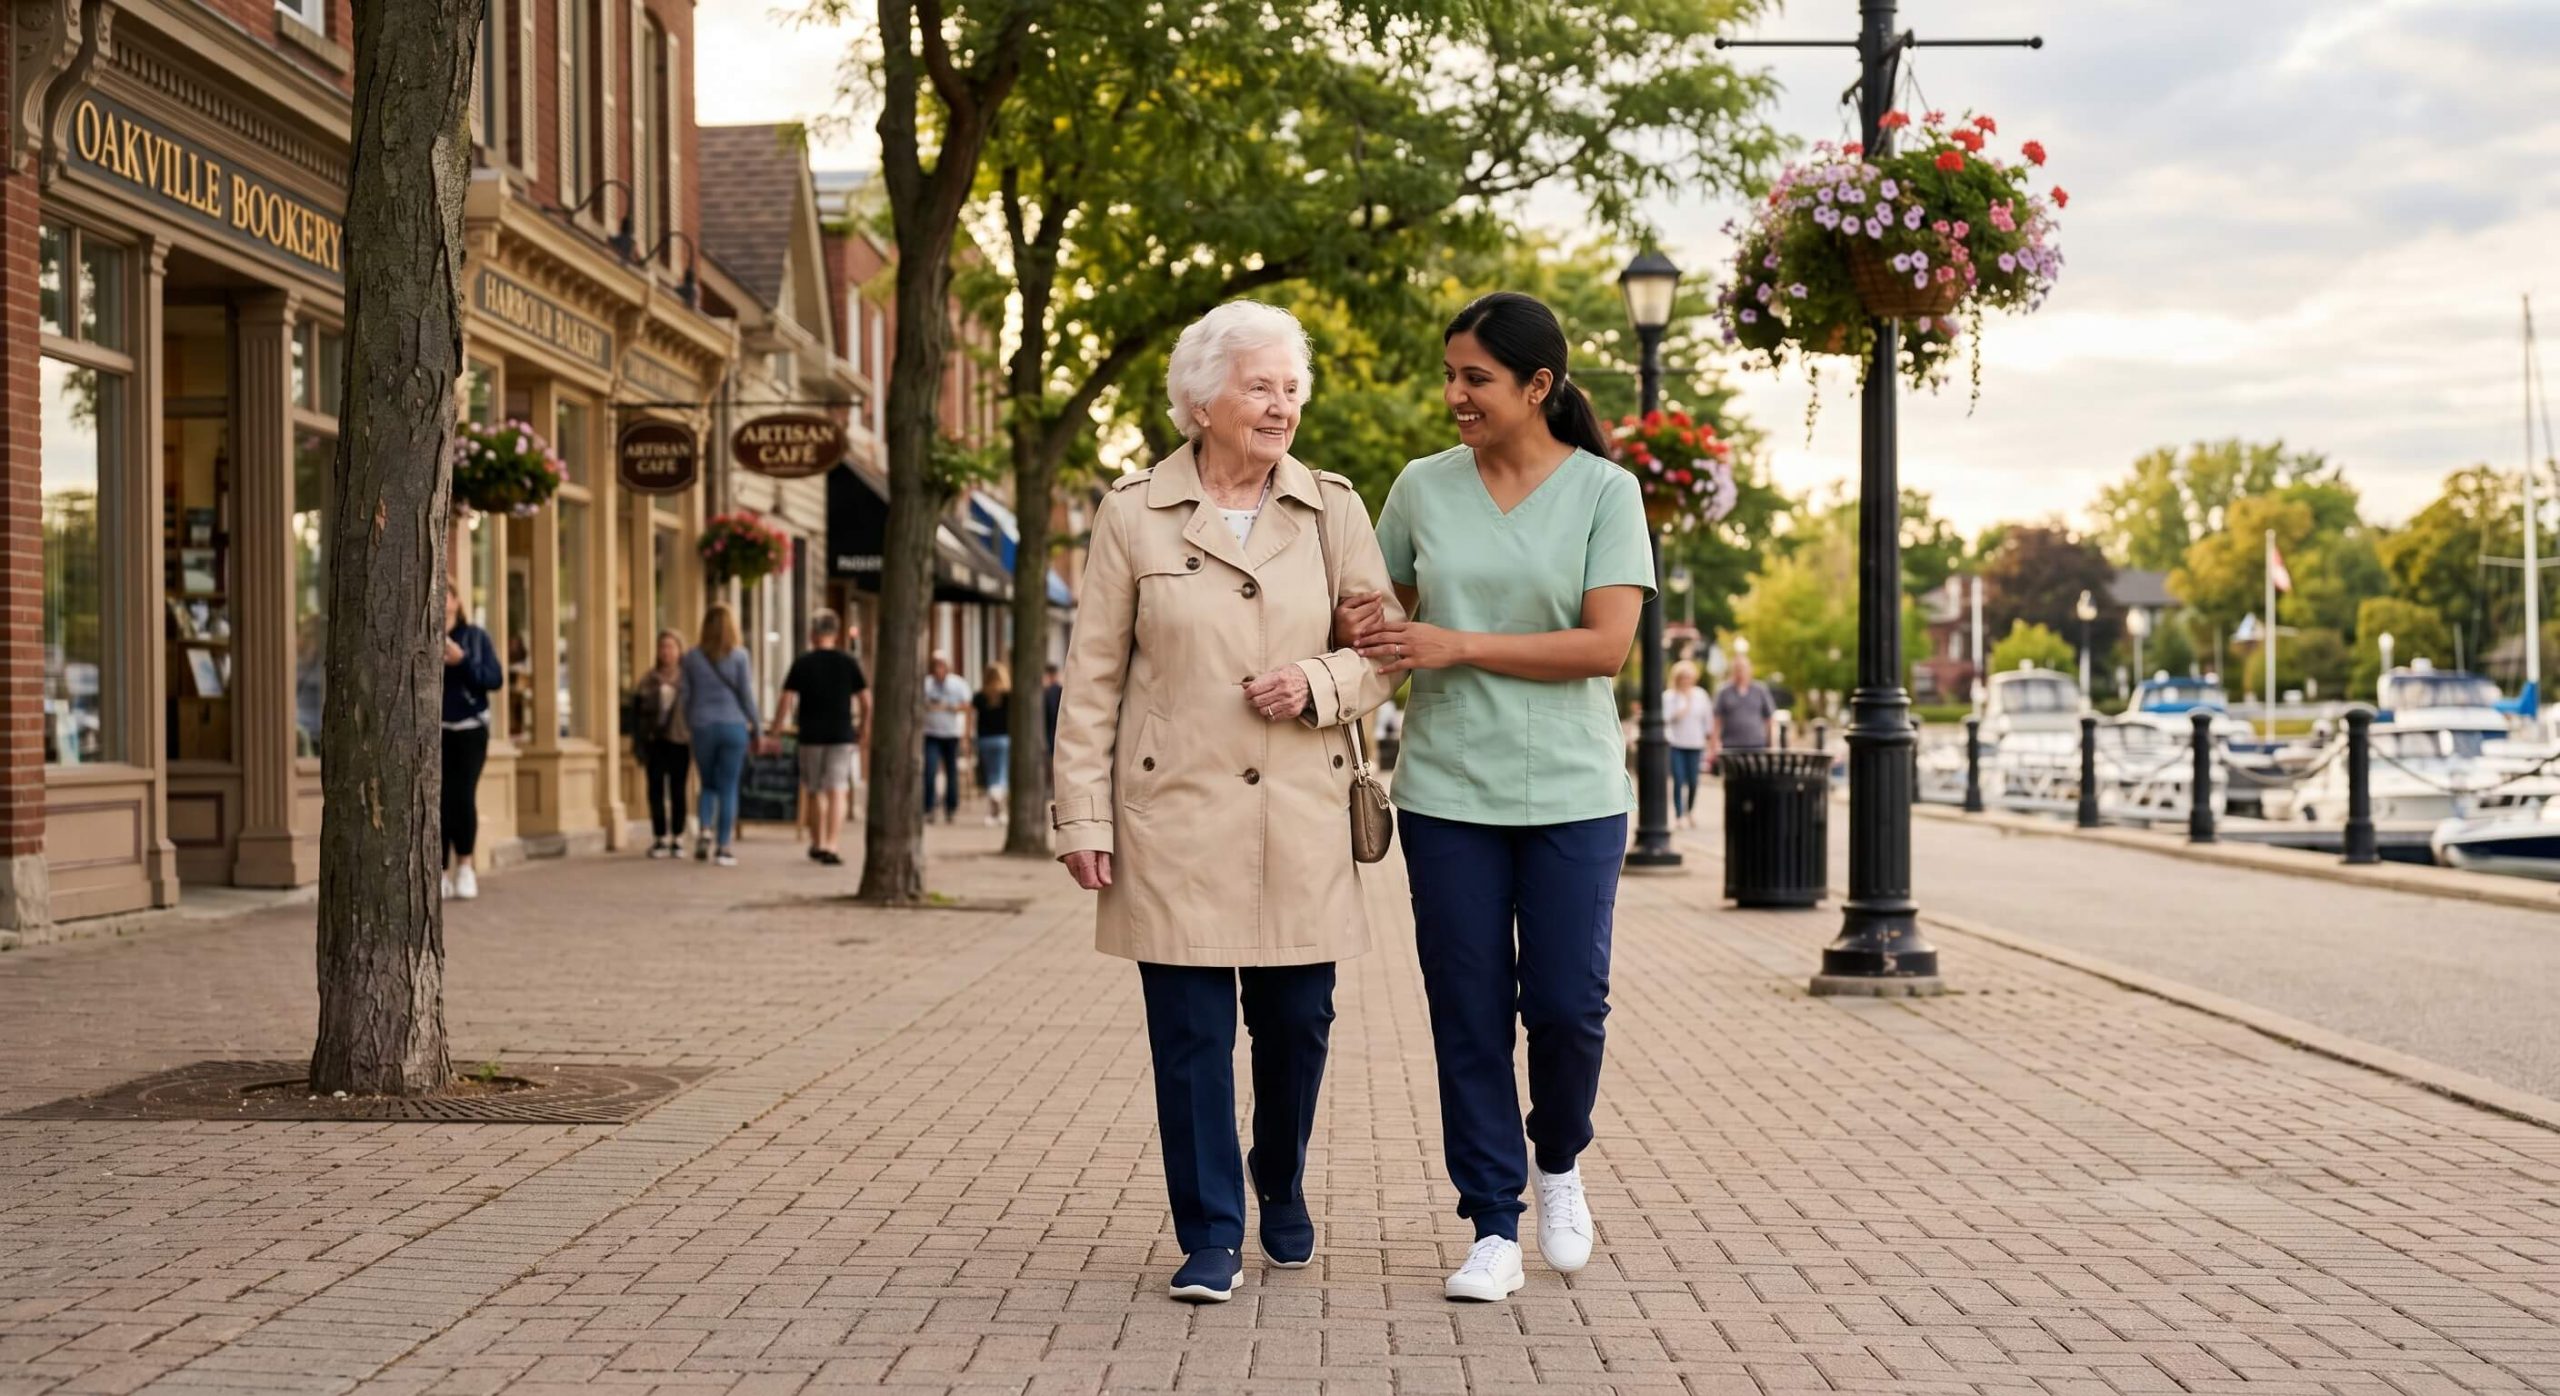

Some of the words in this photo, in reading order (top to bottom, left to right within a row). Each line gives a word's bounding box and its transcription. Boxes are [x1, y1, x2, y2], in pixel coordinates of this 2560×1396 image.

[78, 100, 221, 218] OAKVILLE
[232, 174, 342, 272] BOOKERY
[485, 272, 553, 339] HARBOUR
[555, 309, 603, 363] BAKERY
[625, 442, 690, 458] ARTISAN
[742, 424, 834, 443] ARTISAN
